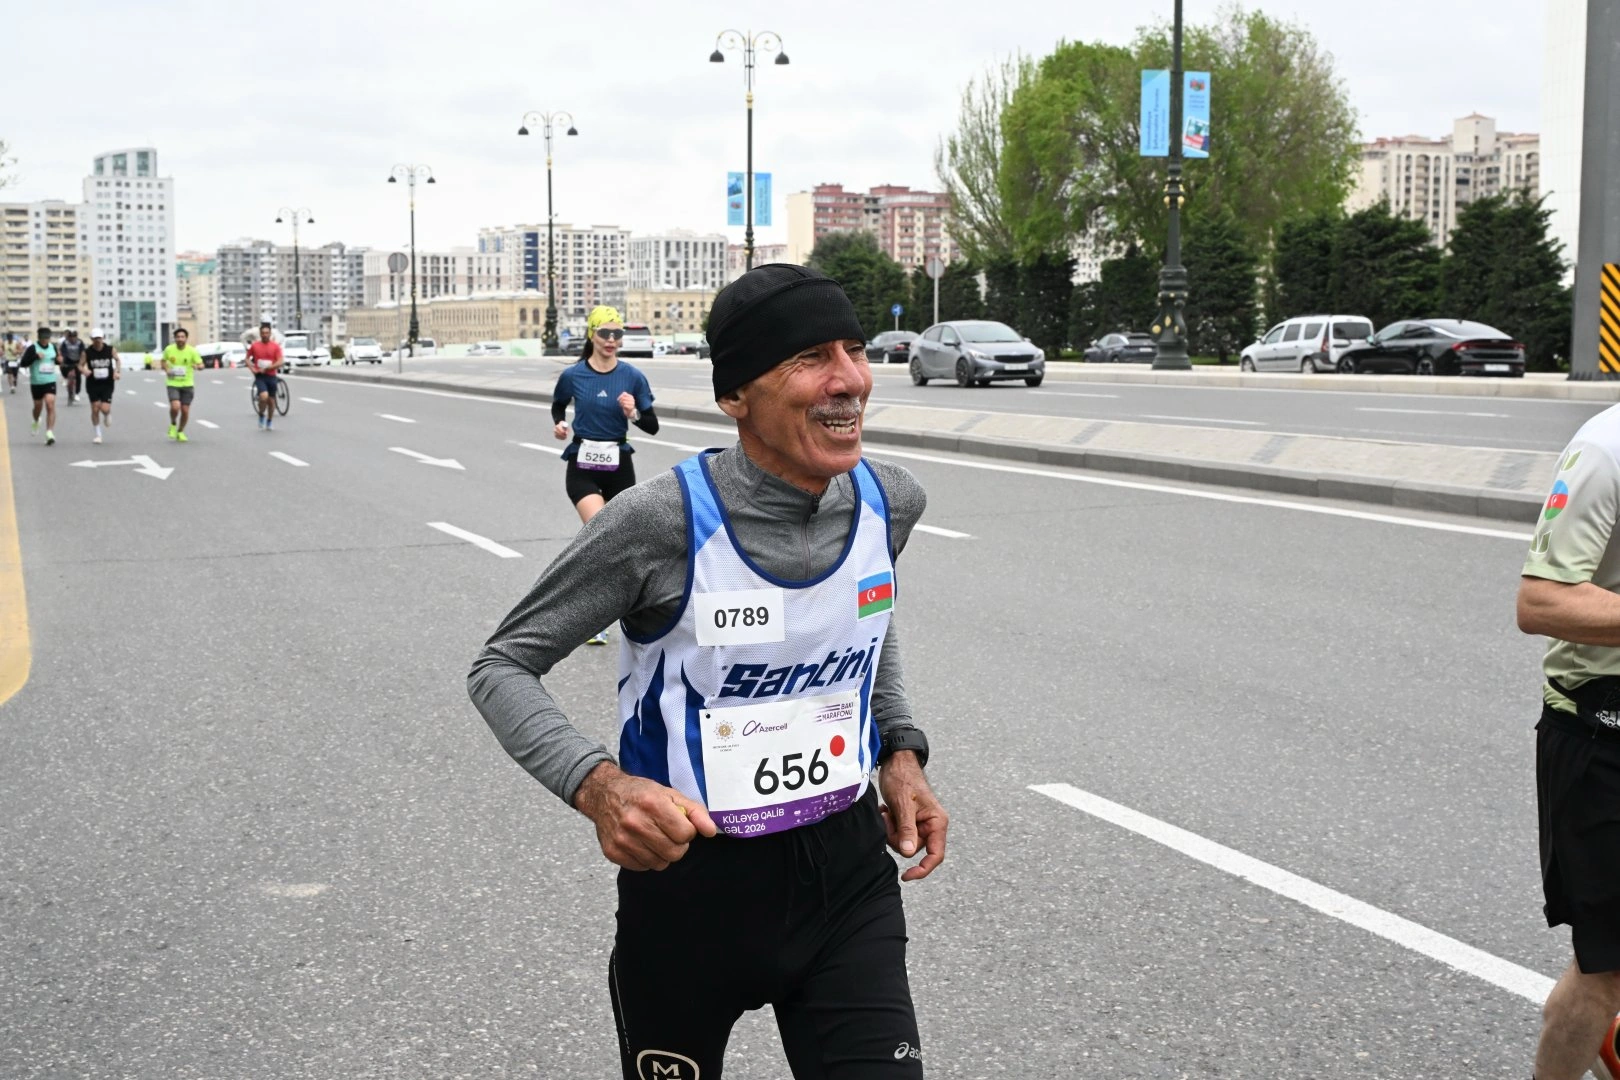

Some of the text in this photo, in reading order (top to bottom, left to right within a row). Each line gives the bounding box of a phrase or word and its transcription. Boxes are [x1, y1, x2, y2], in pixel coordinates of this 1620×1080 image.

[585, 452, 612, 463] 5256
[714, 606, 769, 629] 0789
[718, 637, 879, 698] Santini
[759, 722, 788, 734] Azercell
[753, 748, 829, 796] 656
[722, 808, 785, 824] KÜLƏYƏ QALİB
[724, 823, 766, 834] GƏL 2026
[652, 1060, 680, 1077] M
